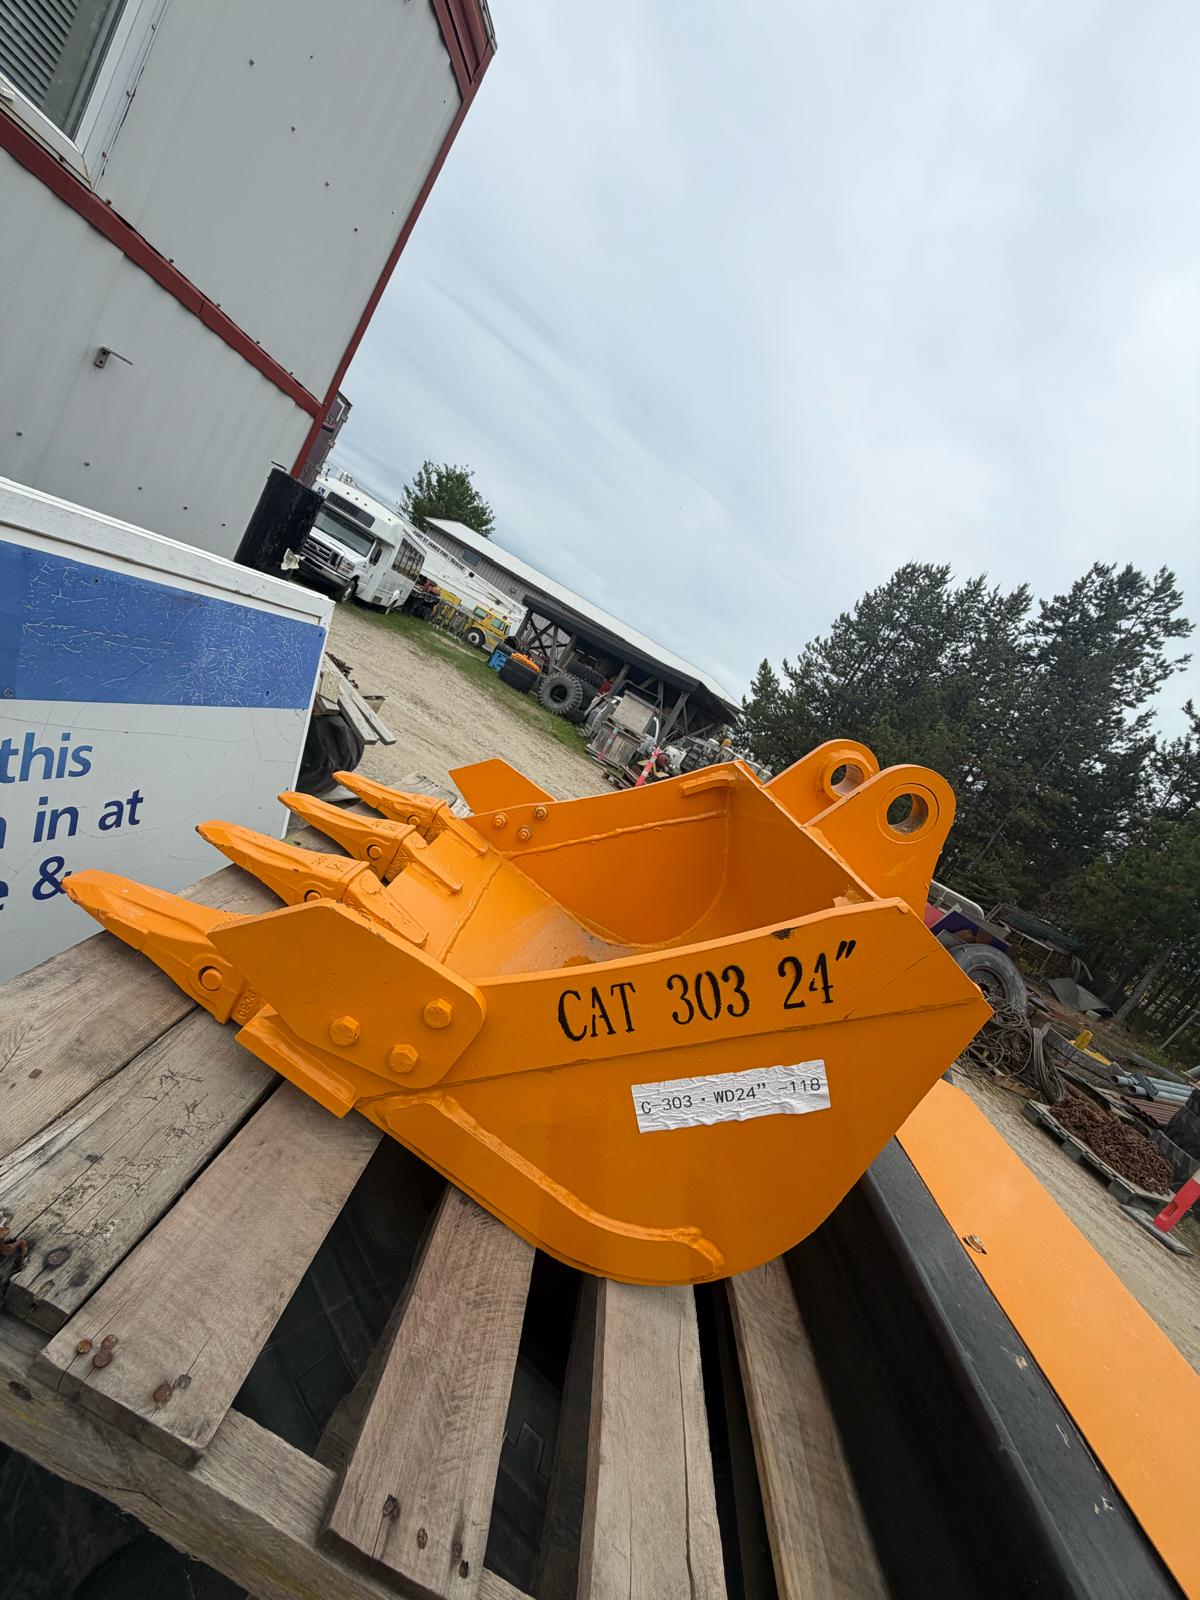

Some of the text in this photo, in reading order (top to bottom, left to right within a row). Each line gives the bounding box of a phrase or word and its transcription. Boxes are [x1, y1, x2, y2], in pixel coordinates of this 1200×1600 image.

[0, 732, 93, 784] this
[32, 796, 79, 843] in
[97, 789, 144, 831] at
[557, 981, 636, 1042] CAT
[666, 964, 751, 1025] 303
